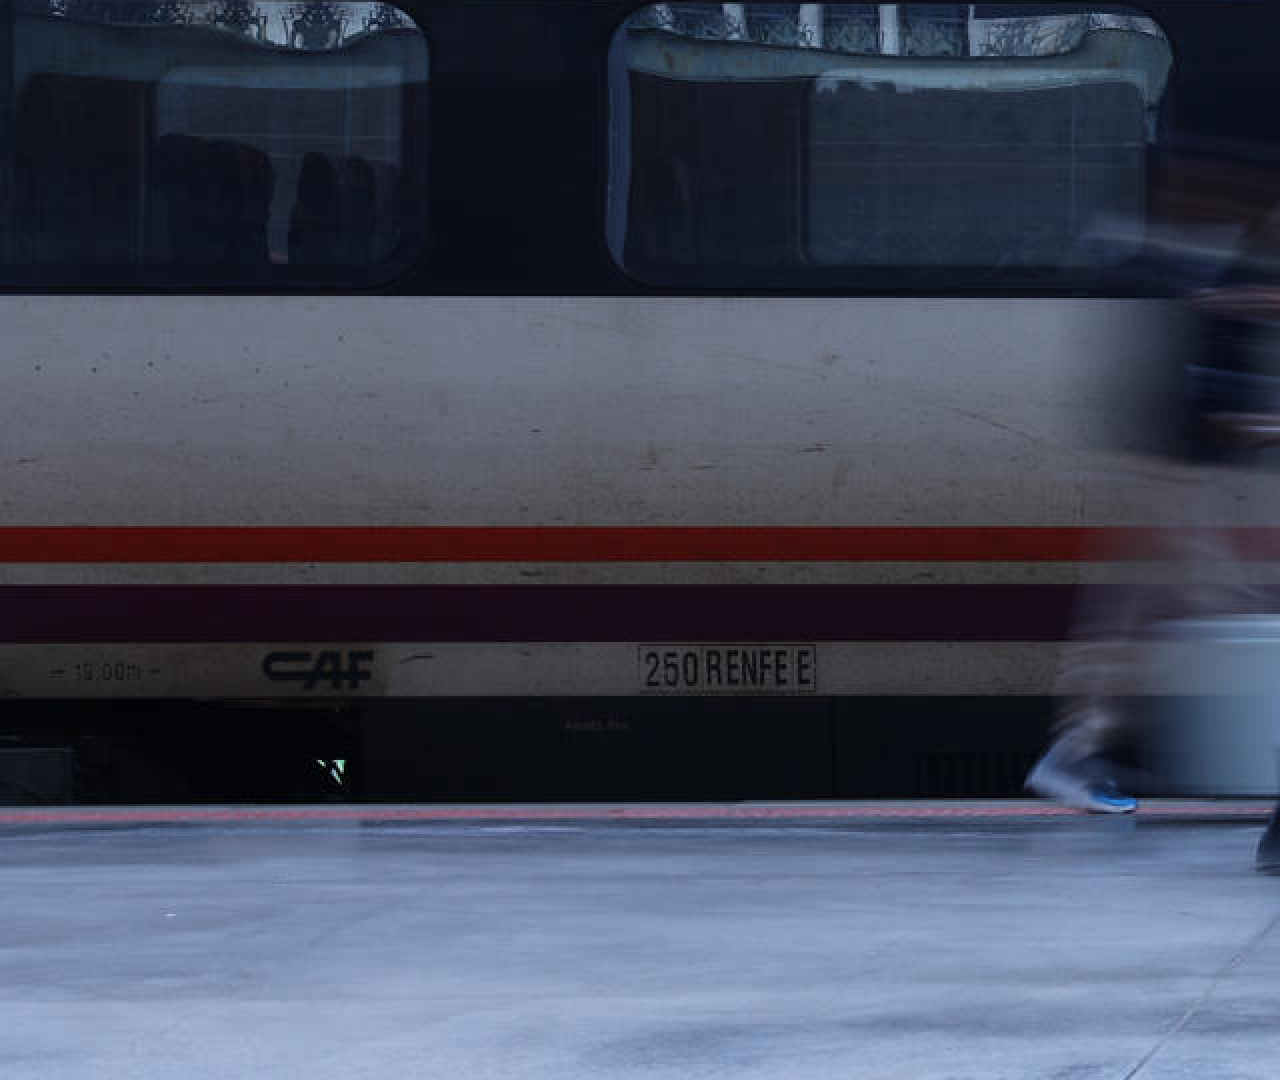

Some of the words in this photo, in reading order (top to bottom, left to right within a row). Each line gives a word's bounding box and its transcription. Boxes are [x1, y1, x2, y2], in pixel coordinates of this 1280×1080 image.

[262, 649, 373, 690] CAF
[645, 651, 699, 686] 250
[706, 650, 788, 686] RENFE
[797, 650, 811, 685] E
